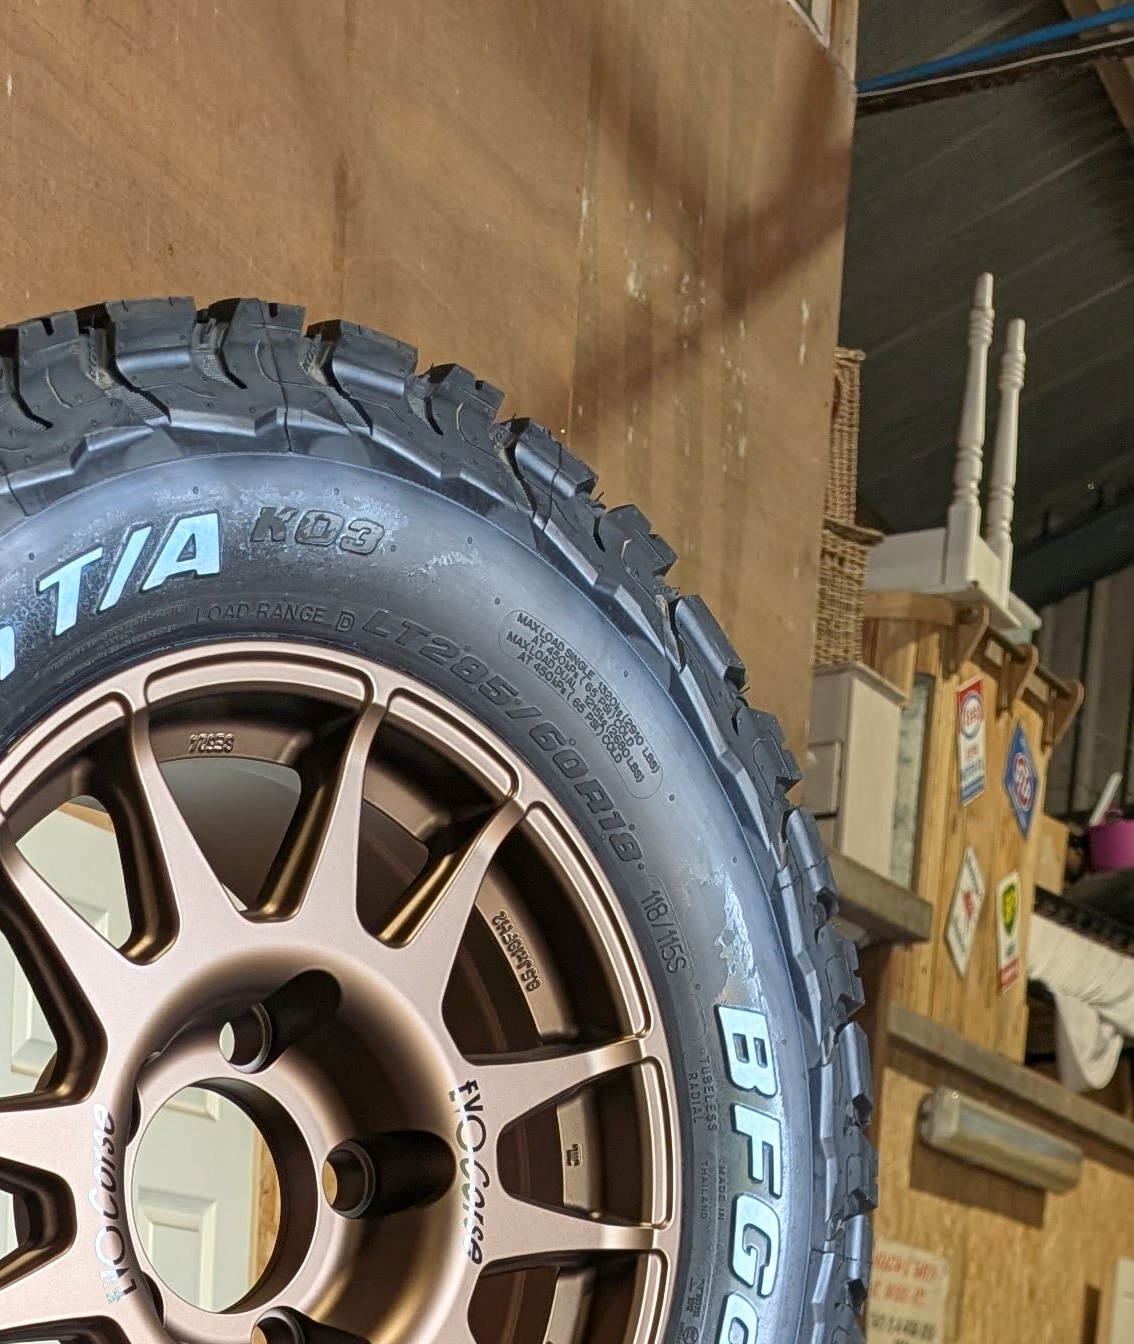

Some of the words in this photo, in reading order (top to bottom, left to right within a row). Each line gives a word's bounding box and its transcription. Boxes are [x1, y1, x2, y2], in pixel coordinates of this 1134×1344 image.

[39, 512, 220, 637] T/A
[195, 602, 249, 624] LOAD
[256, 602, 327, 624] RANGE
[335, 609, 355, 633] D
[506, 630, 529, 652] MAX
[528, 647, 556, 672] LOAD
[555, 666, 578, 691] DUAL
[517, 612, 539, 634] MAX
[539, 628, 565, 652] LOAD
[565, 647, 595, 681] SINGLE
[597, 681, 624, 719] 1320kg
[531, 635, 547, 649] AT
[613, 718, 635, 748] COLD
[363, 609, 643, 865] LT285/60R18
[517, 652, 533, 666] AT
[601, 734, 623, 764] COLD
[640, 885, 692, 976] 118/115S
[688, 1072, 703, 1124] RADIAL
[700, 1056, 718, 1132] TUBELESS
[700, 1160, 710, 1220] THAILAND
[717, 1165, 727, 1202] MADE
[717, 1207, 727, 1221] IN
